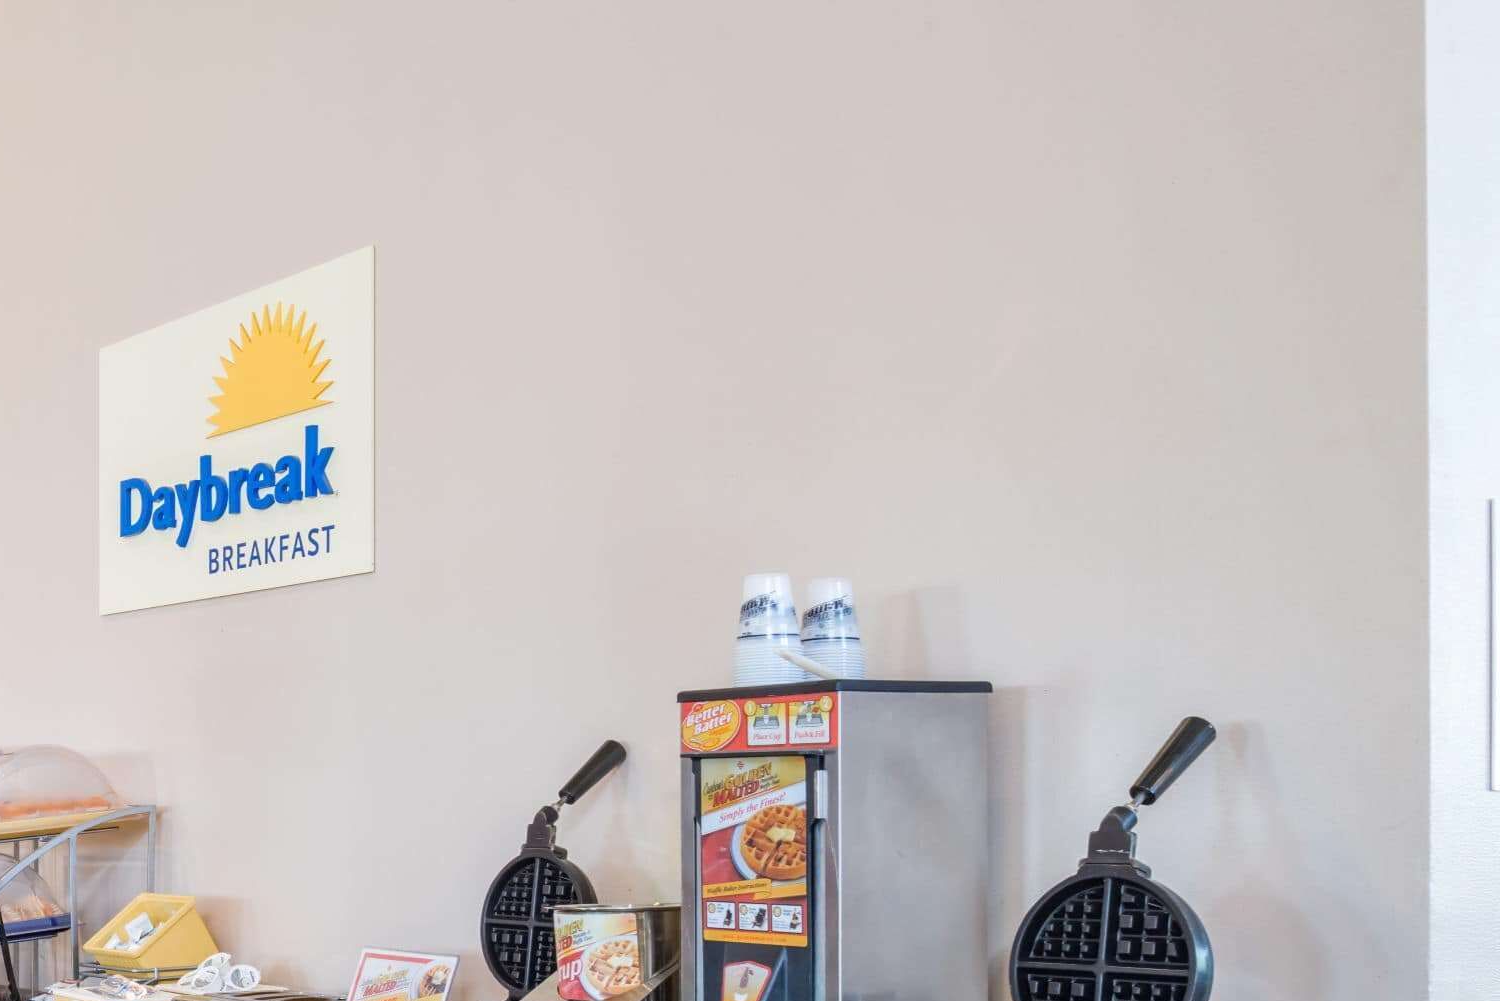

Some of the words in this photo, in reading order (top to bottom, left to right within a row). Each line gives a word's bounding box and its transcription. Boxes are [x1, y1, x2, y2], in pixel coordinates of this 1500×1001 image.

[119, 424, 336, 548] Daybreak
[208, 524, 336, 575] BREAKFAST
[686, 702, 726, 728] Better
[694, 711, 733, 735] Batter
[712, 780, 761, 808] MALTED
[719, 806, 744, 824] Simply
[746, 801, 759, 814] the
